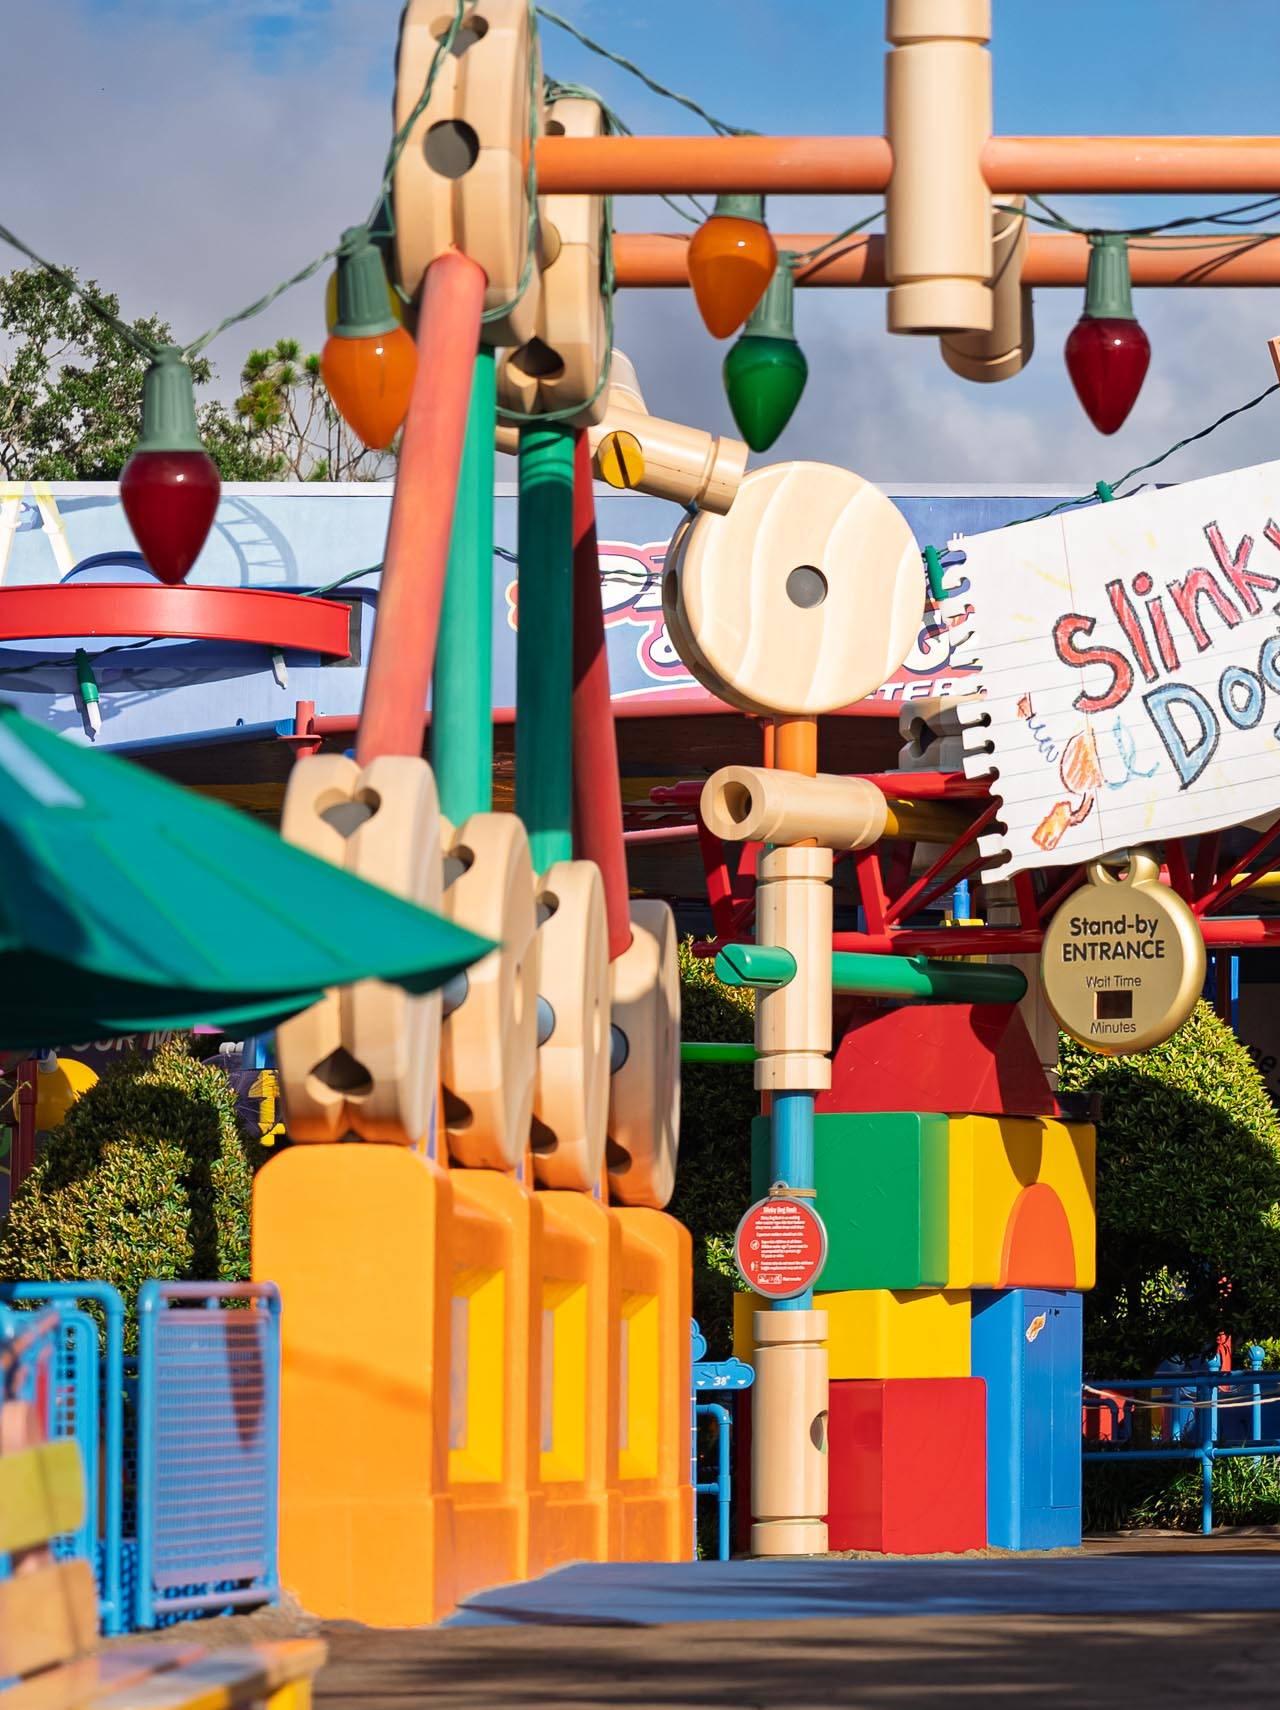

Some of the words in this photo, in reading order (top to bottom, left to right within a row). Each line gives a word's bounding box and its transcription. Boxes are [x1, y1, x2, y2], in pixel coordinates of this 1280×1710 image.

[1069, 914, 1158, 938] Stand-by
[1062, 940, 1165, 962] ENTRANCE
[1086, 976, 1111, 988] Wait
[1113, 975, 1142, 987] Time
[1090, 1022, 1137, 1034] Minutes
